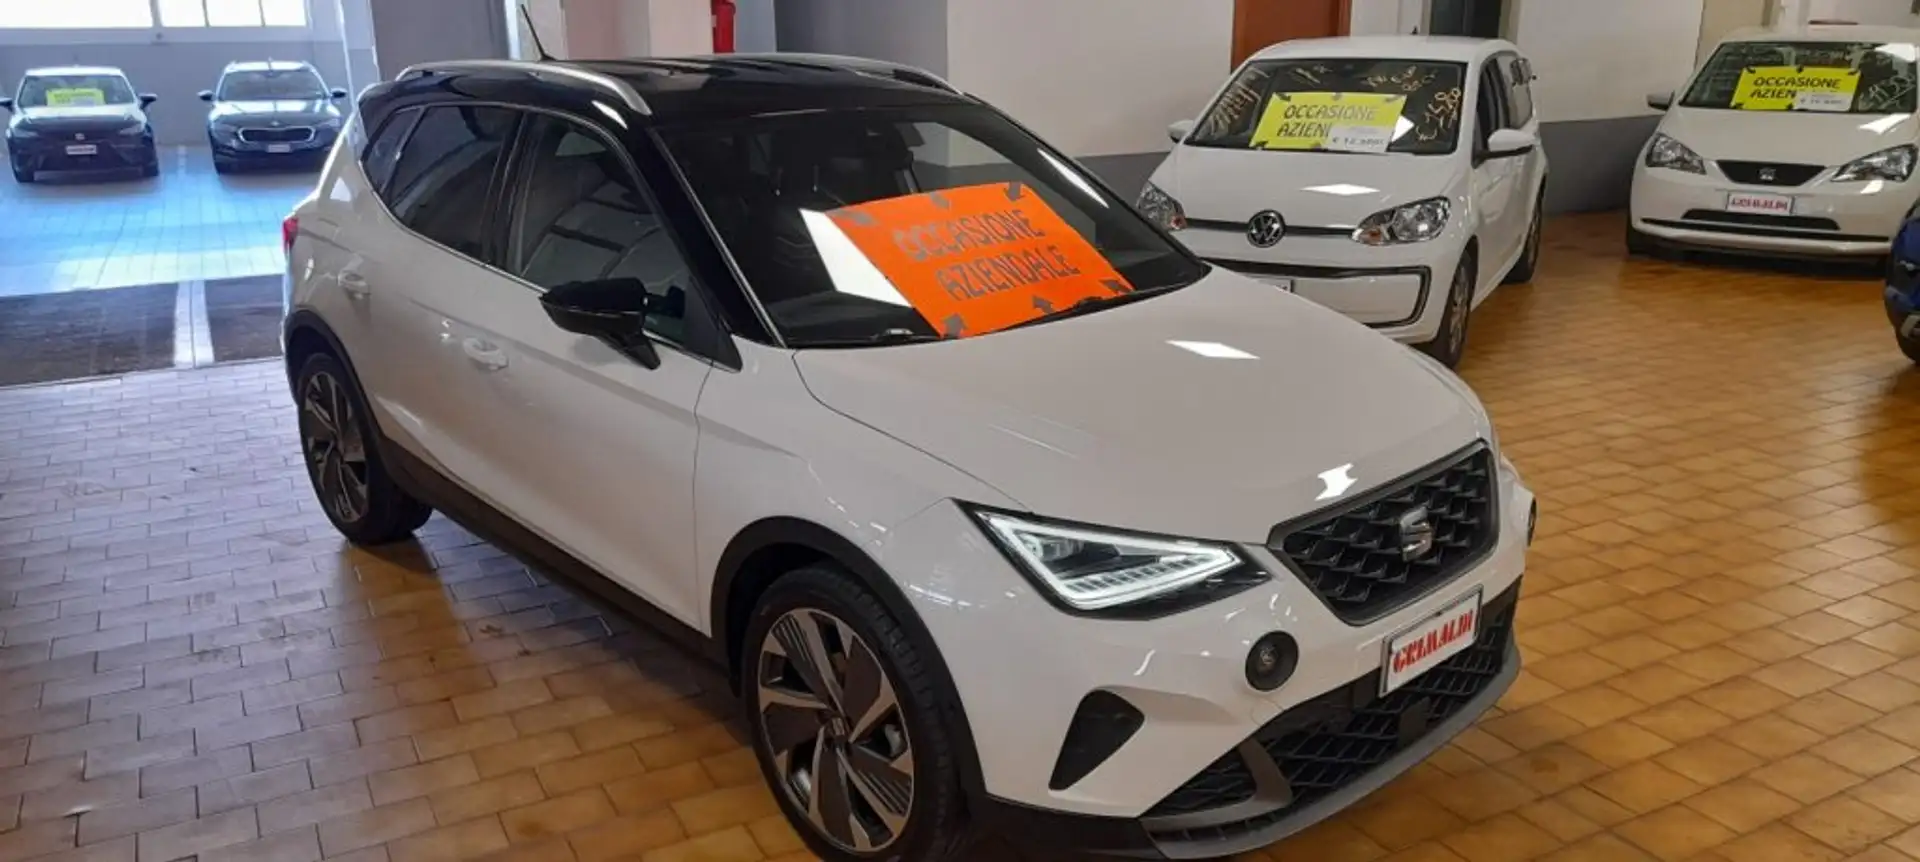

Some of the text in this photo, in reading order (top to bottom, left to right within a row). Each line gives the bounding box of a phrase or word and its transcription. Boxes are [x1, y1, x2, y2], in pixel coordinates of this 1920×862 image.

[1753, 76, 1841, 89] OCCASIONE
[1749, 88, 1797, 99] AZIEN
[1284, 104, 1378, 121] OCCASIONE
[1276, 121, 1332, 139] AZIEN
[893, 209, 1046, 262] OCCASIONE
[936, 244, 1081, 301] AZIENDALE
[1392, 609, 1474, 674] GRIMALDI
